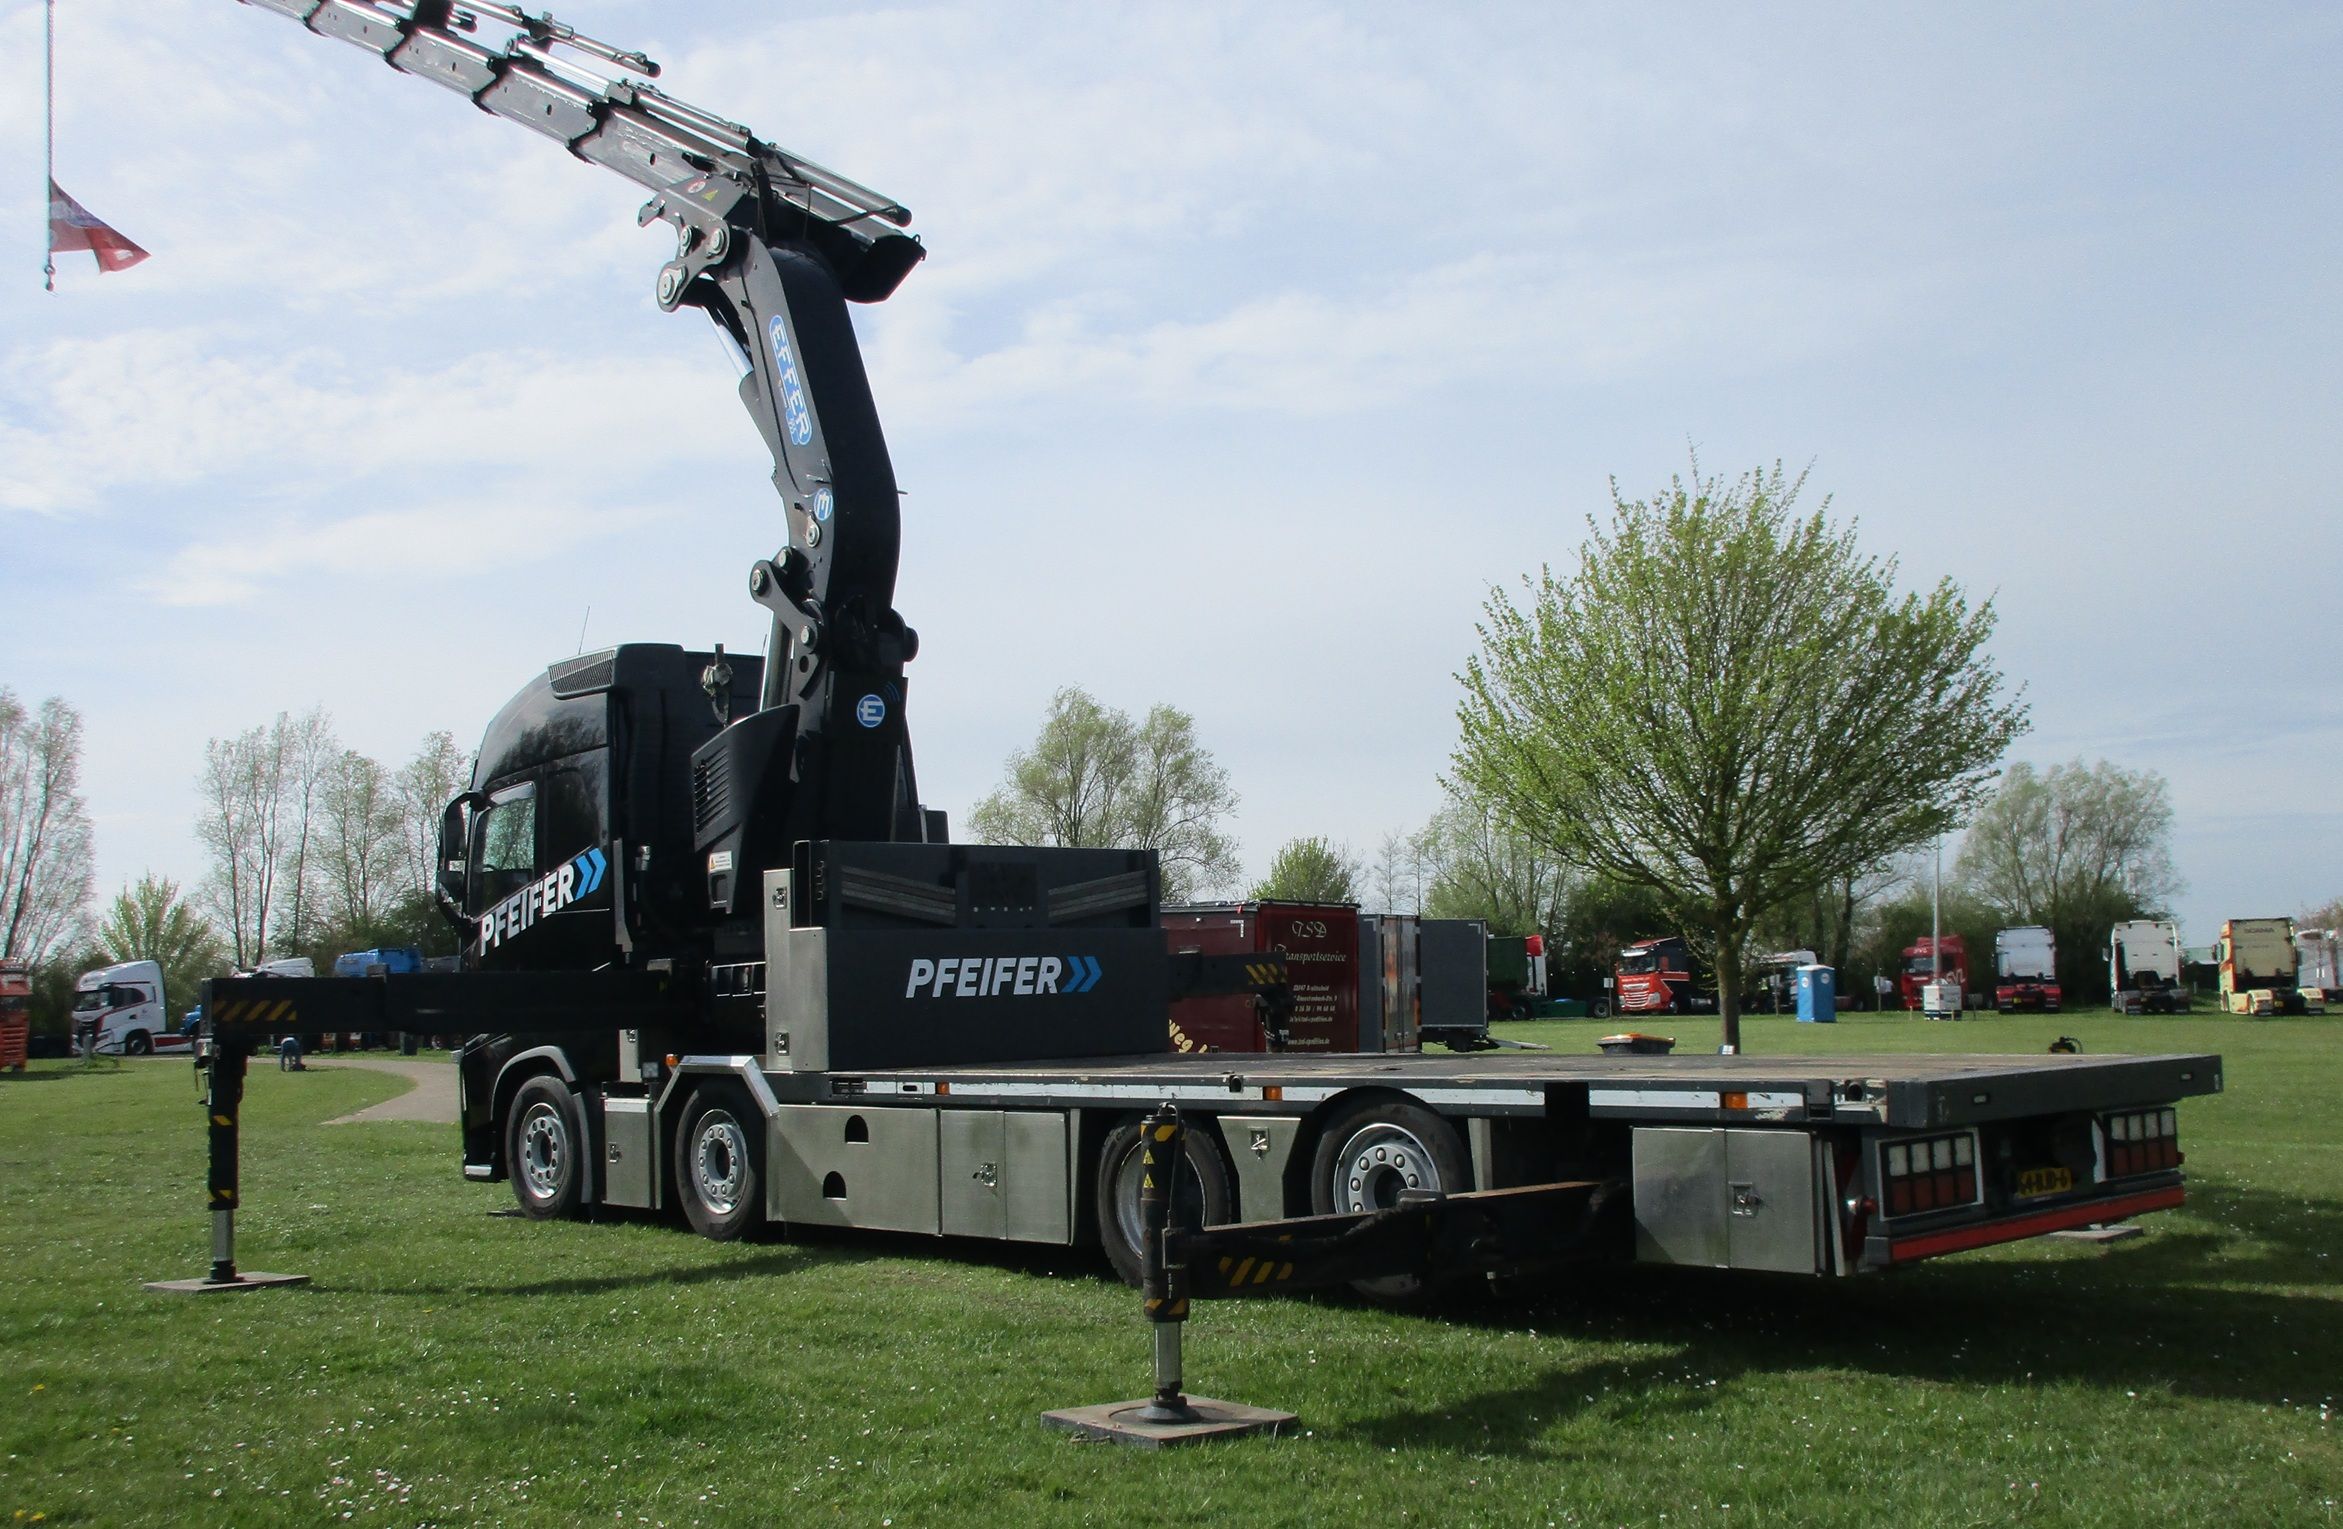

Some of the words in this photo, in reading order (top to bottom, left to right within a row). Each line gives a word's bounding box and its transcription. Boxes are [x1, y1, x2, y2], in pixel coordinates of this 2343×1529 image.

[772, 323, 810, 440] EFFER
[859, 700, 884, 722] E
[479, 863, 576, 957] PFEIFER
[905, 956, 1063, 999] PFEIFER
